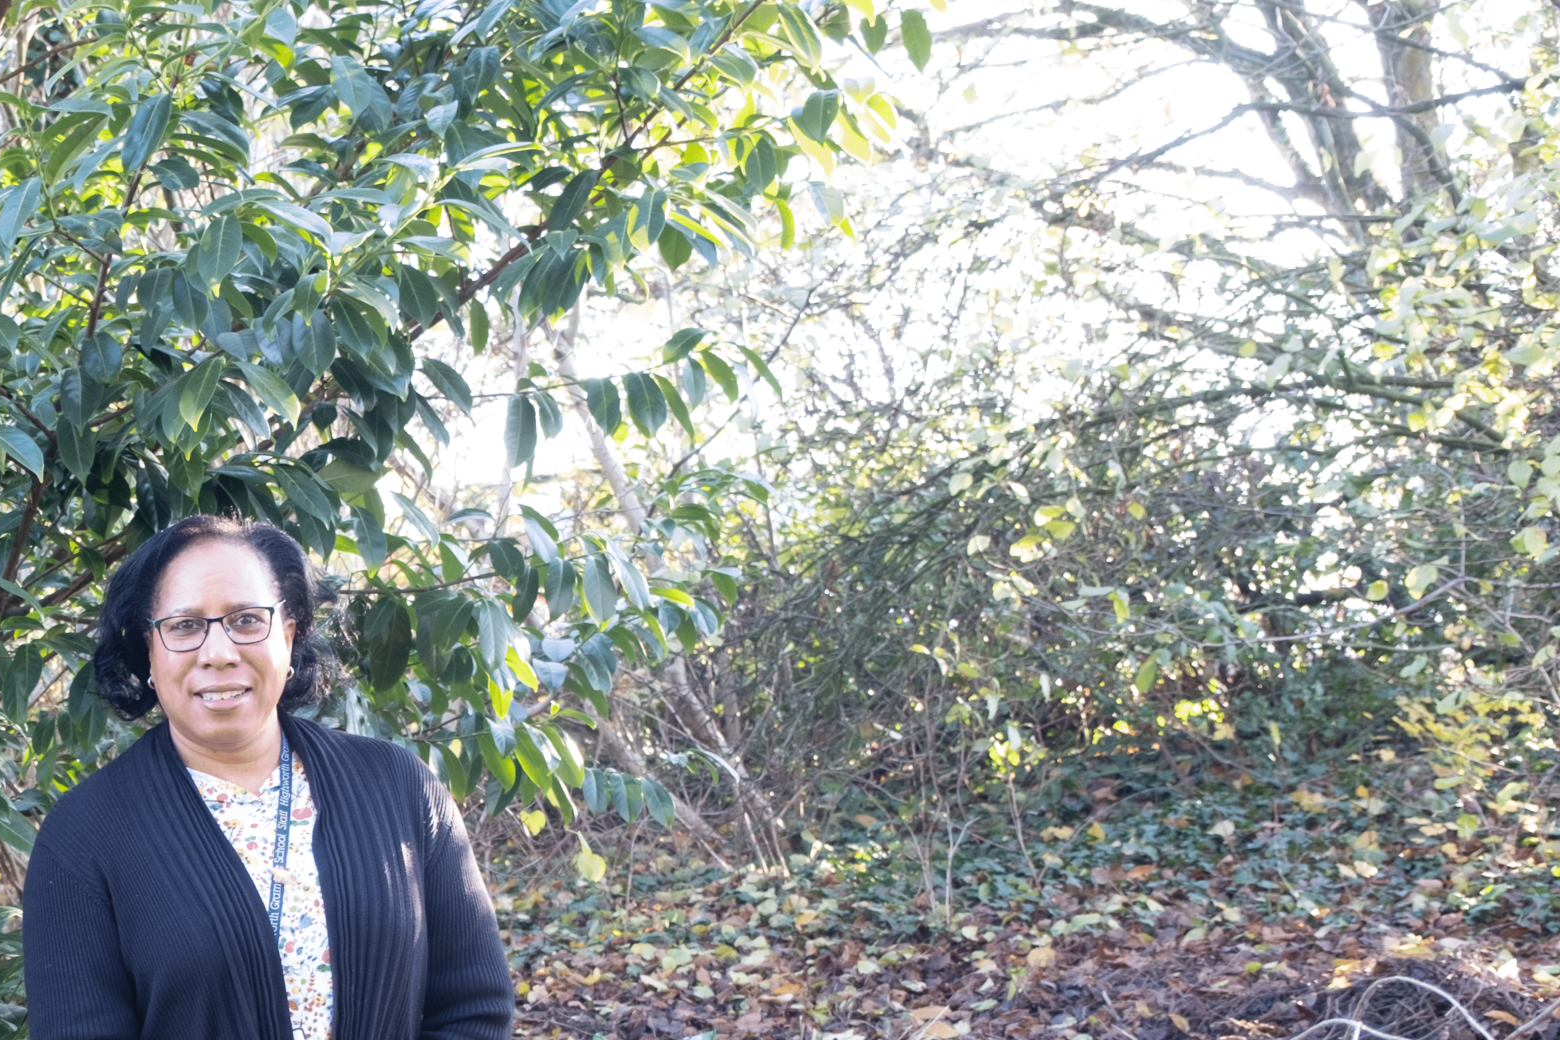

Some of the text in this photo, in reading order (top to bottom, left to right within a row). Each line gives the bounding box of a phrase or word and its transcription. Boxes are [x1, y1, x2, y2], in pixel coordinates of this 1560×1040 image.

[279, 763, 291, 807] Highworth
[277, 810, 288, 830] Staff
[274, 833, 286, 864] School
